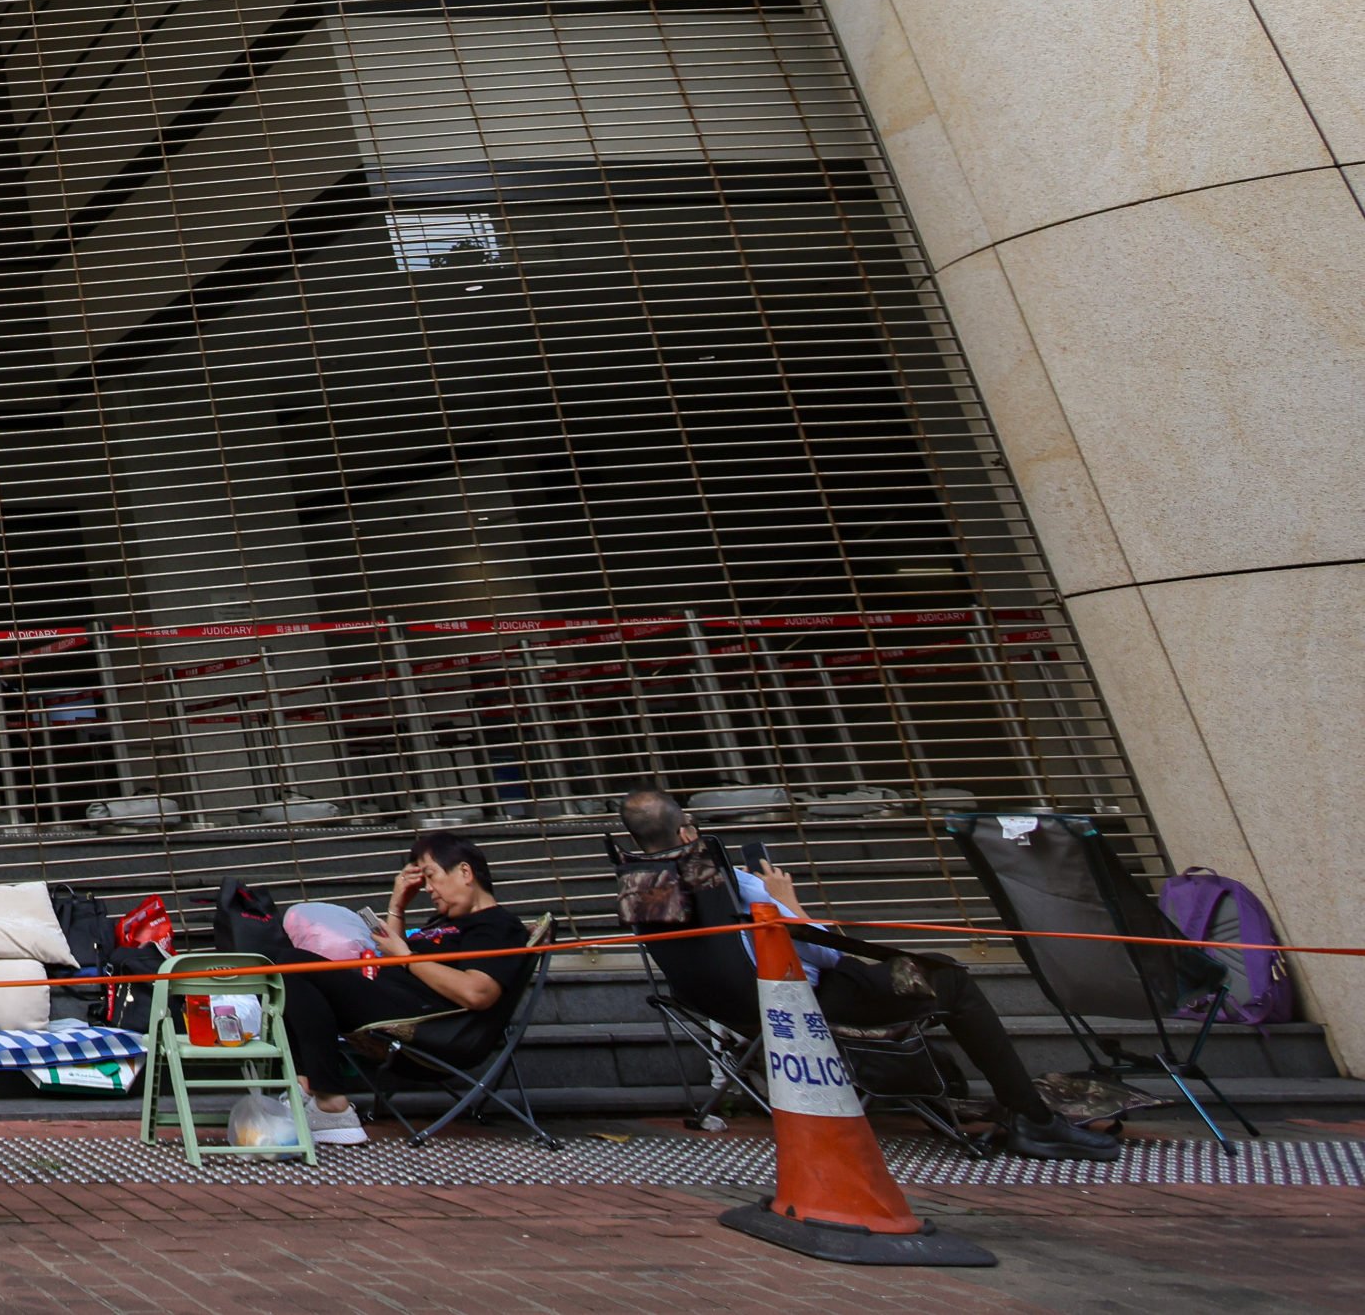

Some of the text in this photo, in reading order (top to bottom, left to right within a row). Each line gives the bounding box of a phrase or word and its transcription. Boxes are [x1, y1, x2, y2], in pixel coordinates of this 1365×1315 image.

[434, 620, 469, 631] 司法機構
[490, 619, 542, 631] JUDICIARY
[783, 615, 835, 626] JUDICIARY
[916, 611, 967, 623] JUDICIARY
[201, 625, 253, 636] JUDICIARY
[275, 623, 311, 634] 司法機構
[766, 1008, 832, 1041] 警察
